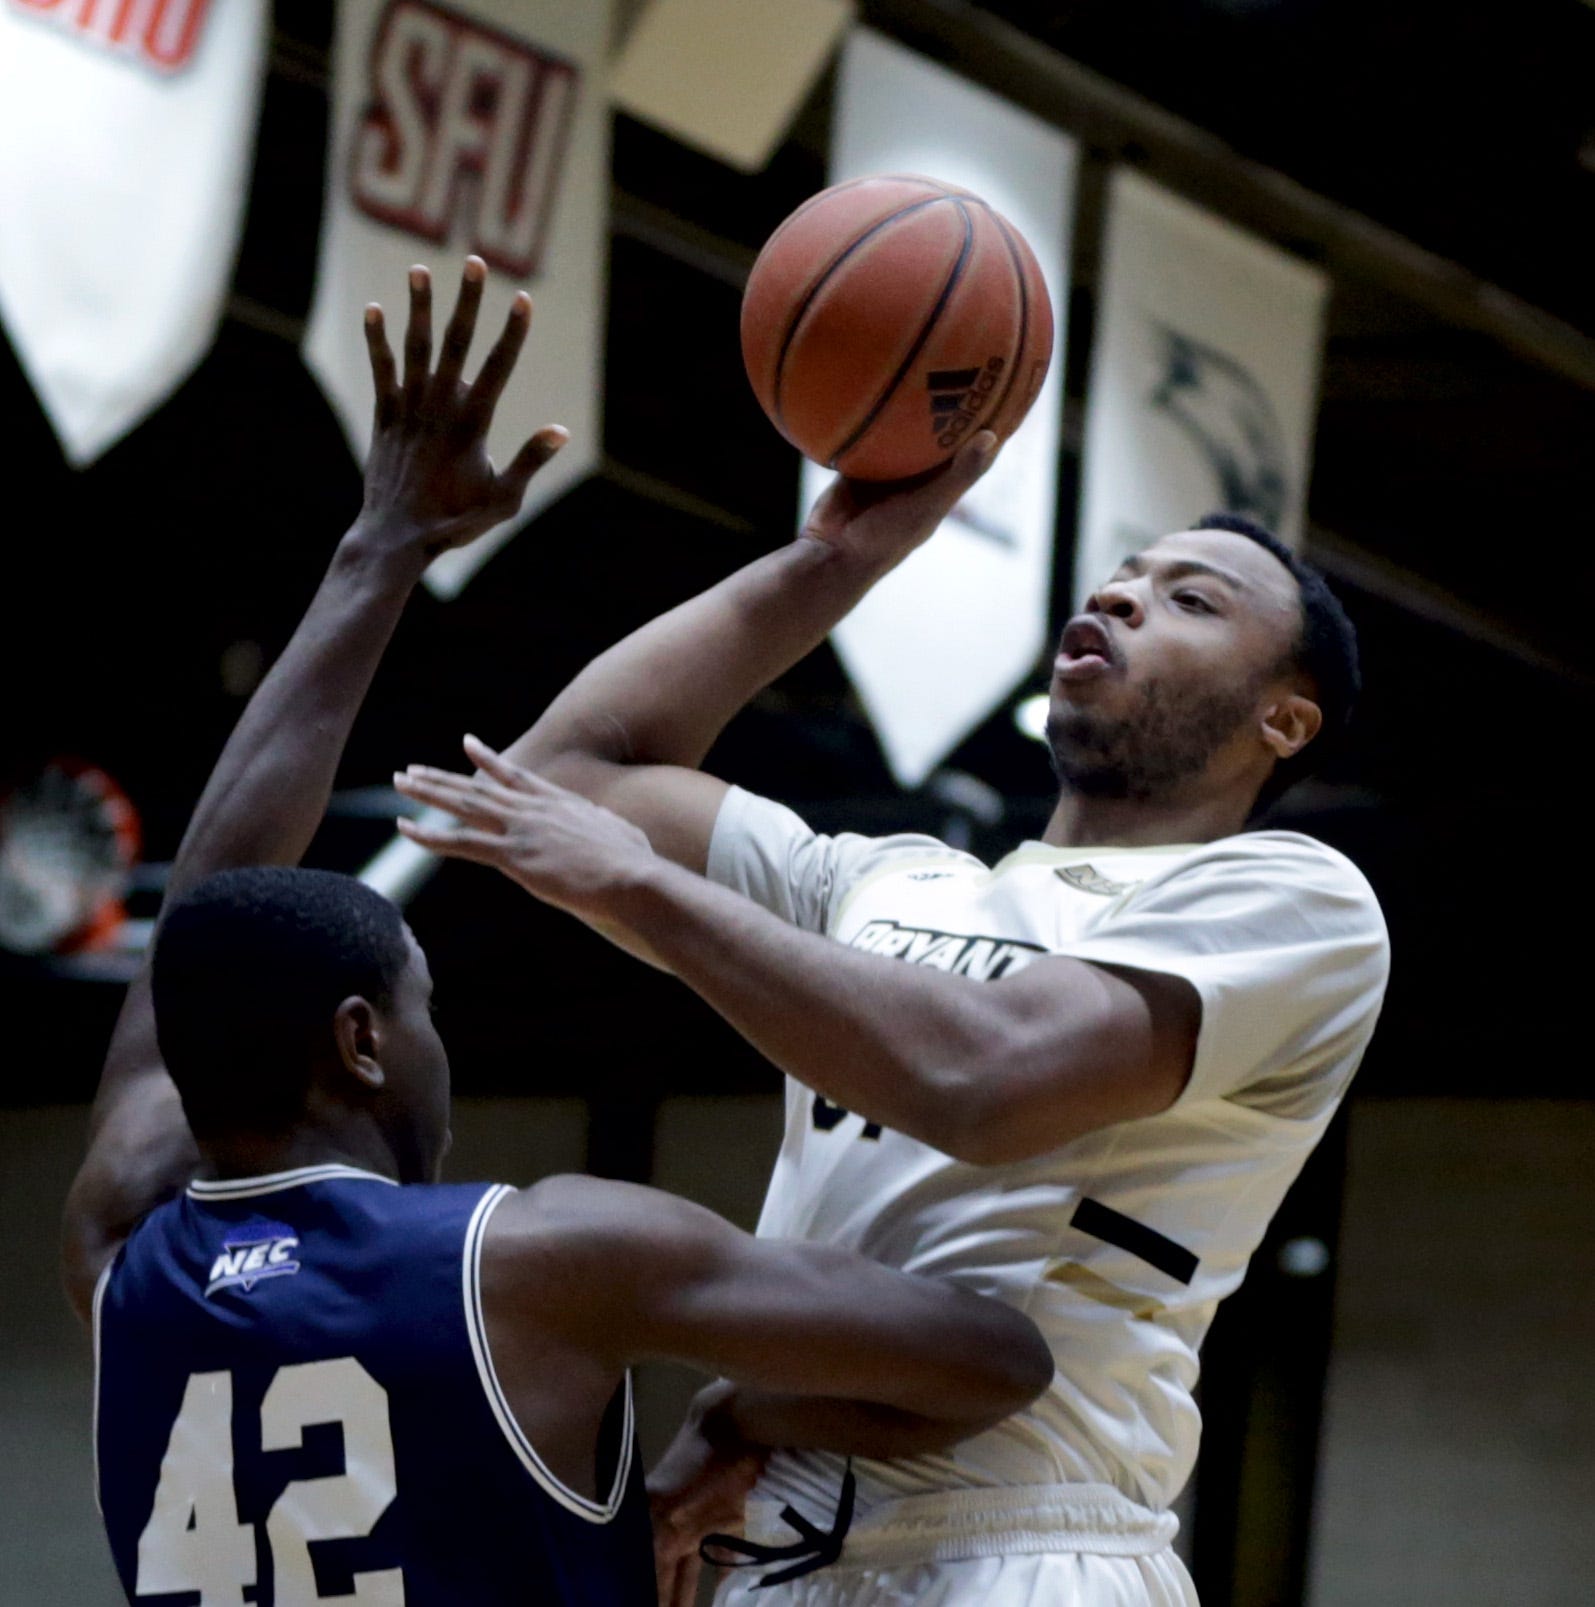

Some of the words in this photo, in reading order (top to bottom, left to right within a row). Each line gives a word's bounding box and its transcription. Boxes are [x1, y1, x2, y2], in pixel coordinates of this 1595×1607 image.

[352, 1, 577, 278] SFU
[936, 355, 1005, 448] adidas
[209, 1237, 299, 1281] NEC
[136, 1356, 406, 1607] 42
